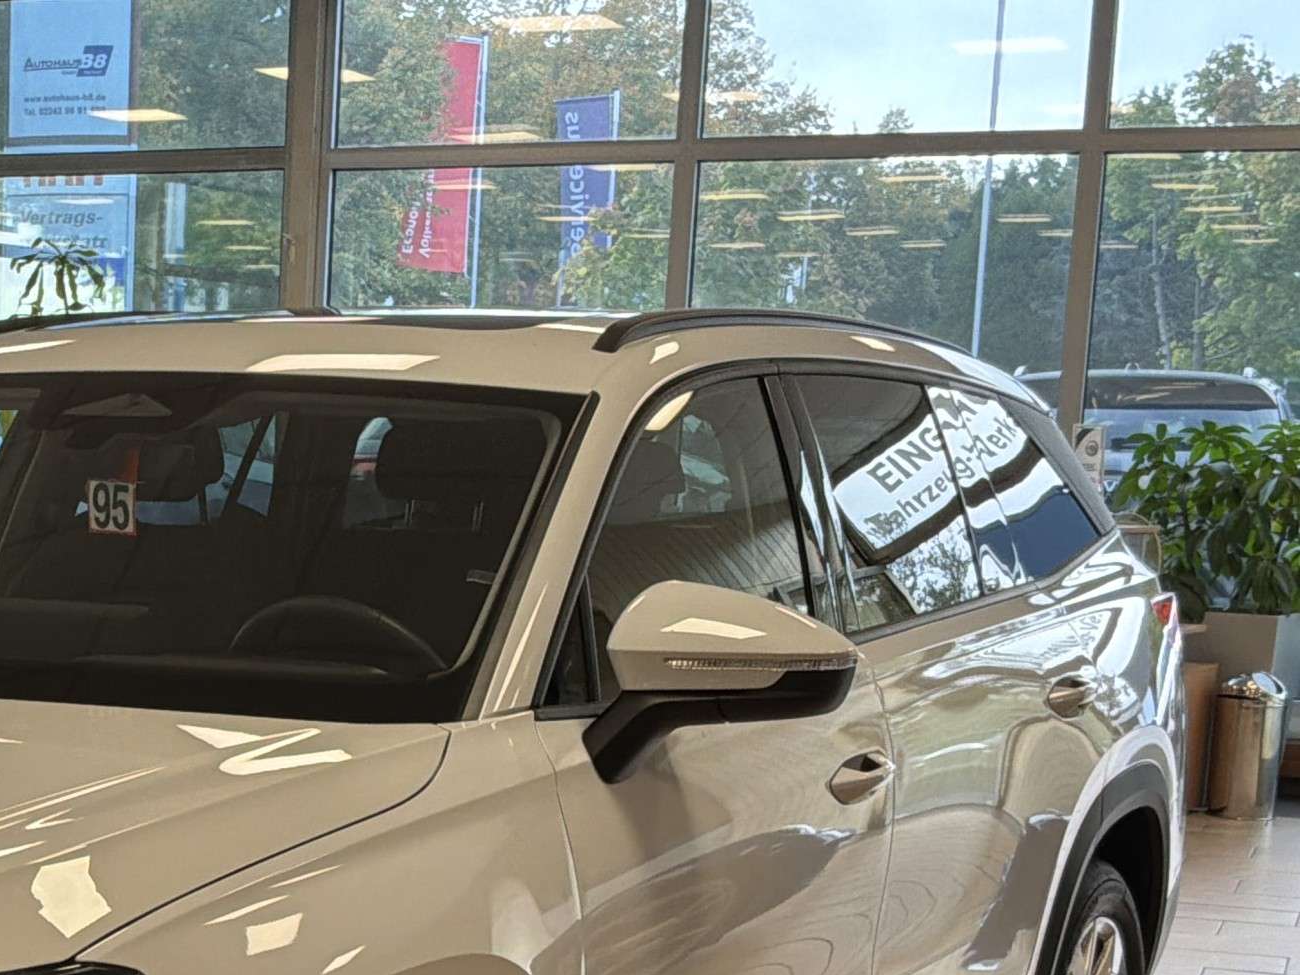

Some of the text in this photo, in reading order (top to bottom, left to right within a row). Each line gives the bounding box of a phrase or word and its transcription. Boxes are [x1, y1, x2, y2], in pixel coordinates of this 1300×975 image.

[24, 53, 107, 69] AUTOHAUS B8
[92, 482, 130, 530] 95
